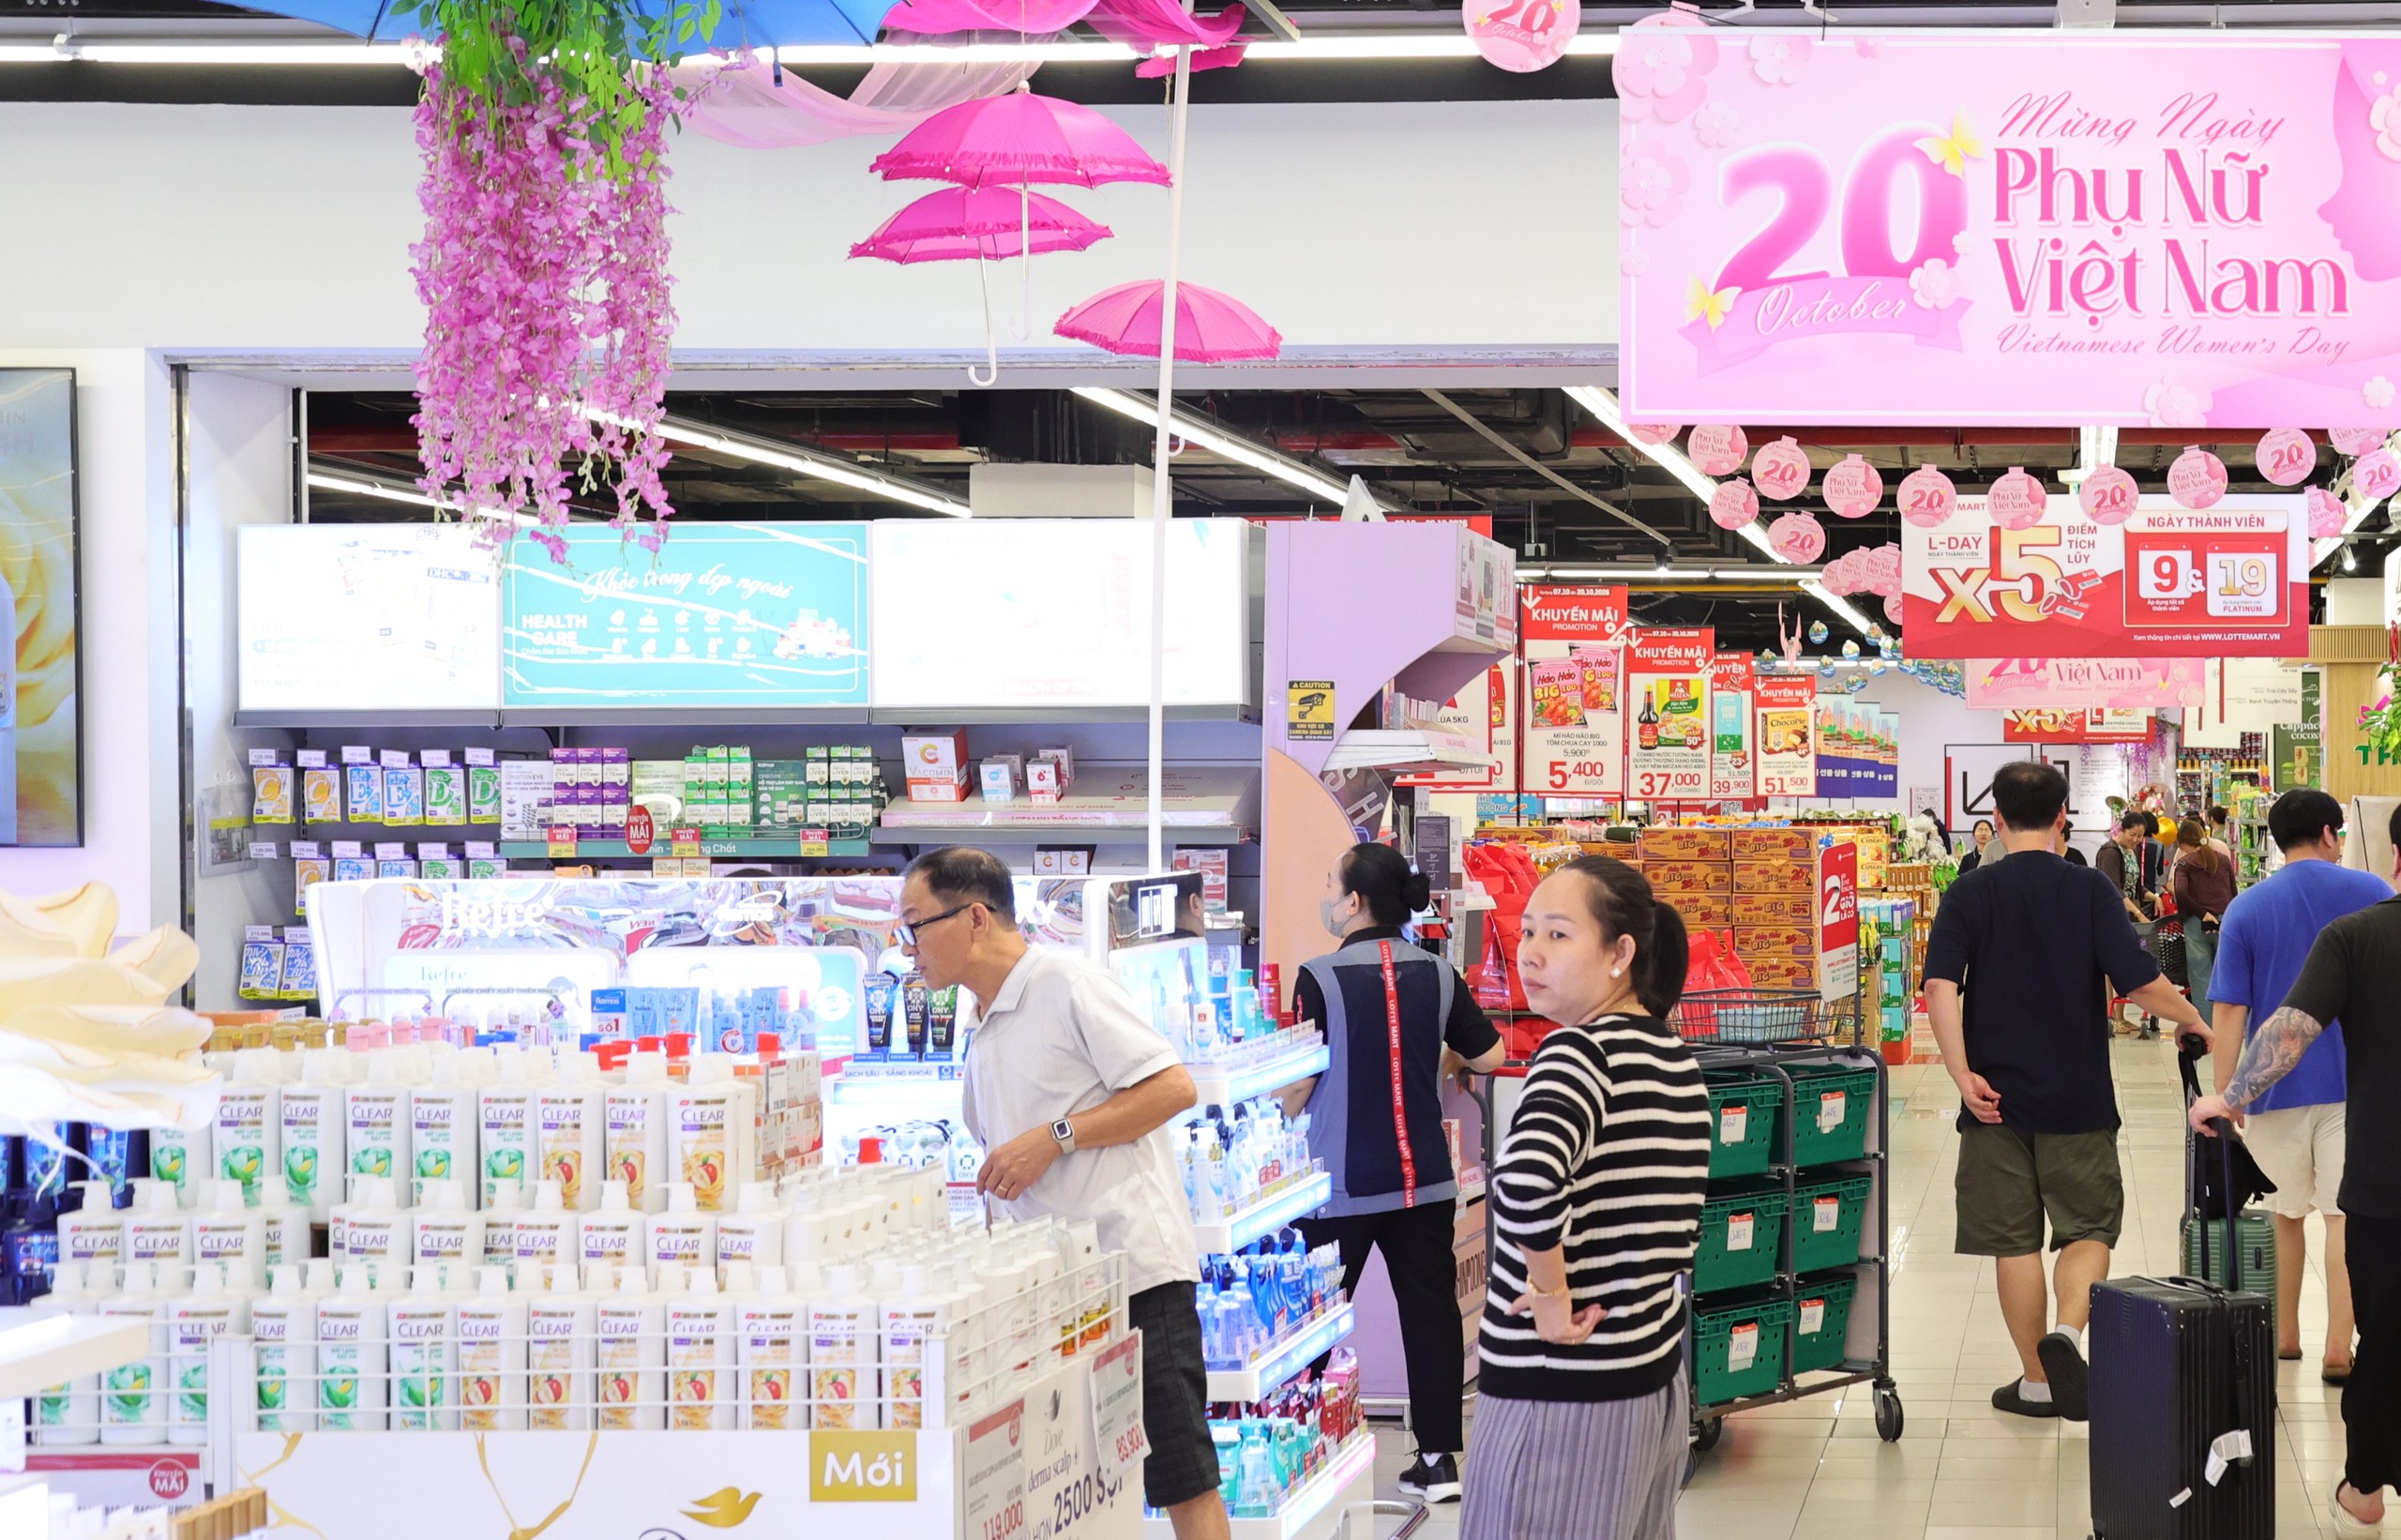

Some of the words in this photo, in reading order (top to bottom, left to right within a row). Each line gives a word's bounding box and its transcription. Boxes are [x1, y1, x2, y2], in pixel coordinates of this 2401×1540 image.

[1998, 91, 2137, 146] Mừng
[2156, 91, 2287, 146] Ngày
[1995, 149, 2144, 237] Phụ
[2162, 149, 2270, 224] Nữ
[1714, 120, 1969, 294] 20
[1995, 237, 2144, 326] Việt
[2163, 239, 2349, 315] Nam
[1755, 282, 1908, 339] October
[1997, 324, 2146, 356] Vietnamese
[2156, 324, 2280, 356] Women's
[2288, 325, 2350, 366] Day
[2271, 444, 2303, 475] 20
[1763, 460, 1799, 481] 20
[2364, 463, 2393, 488] 20
[1910, 489, 1945, 509] 20
[2093, 484, 2127, 511] 20
[1957, 503, 1986, 511] MART
[2148, 514, 2182, 527] NGÀY
[2187, 514, 2231, 527] THÀNH
[2234, 514, 2265, 527] VIÊN
[1786, 530, 1815, 550] 20
[1928, 536, 1983, 550] L-DAY
[2068, 536, 2095, 550] TÍCH
[2068, 552, 2091, 564] LŨY
[2153, 555, 2179, 593] 9
[2185, 568, 2206, 593] &
[2219, 559, 2267, 596] 19
[521, 614, 588, 628] HEALTH
[1532, 606, 1591, 621] KHUYẾN
[1592, 607, 1618, 622] MÃI
[2147, 634, 2163, 642] thông
[1635, 645, 1683, 657] KHUYẾN
[1684, 645, 1706, 657] MÃI
[2056, 660, 2091, 684] Việt
[2096, 663, 2141, 682] Nam
[1534, 684, 1561, 701] BIG
[1760, 687, 1793, 697] KHUYẾN
[1795, 688, 1810, 697] MÃI
[1771, 717, 1805, 728] ChocoPie
[908, 766, 955, 777] VACOMIN
[1548, 762, 1604, 789] 5,400
[430, 781, 449, 802] D
[476, 780, 495, 802] D
[1639, 773, 1700, 795] 37,000
[1713, 780, 1749, 793] 39,900
[1765, 777, 1808, 793] 51,500
[630, 822, 649, 838] MÃI
[713, 842, 736, 853] Chất
[1764, 902, 1784, 912] BIG
[1823, 874, 1841, 927] 2
[1752, 940, 1769, 950] BIG
[1382, 944, 1390, 967] LOTTE
[1385, 970, 1395, 991] MART
[1752, 973, 1769, 983] BIG
[596, 997, 620, 1005] Remos
[1391, 1026, 1399, 1049] MART
[1394, 1084, 1402, 1106] MART
[609, 1107, 645, 1121] CLEAR
[681, 1109, 725, 1123] CLEAR
[1397, 1114, 1405, 1138] LOTTE
[72, 1236, 119, 1250] CLEAR
[133, 1235, 179, 1249] CLEAR
[201, 1235, 244, 1249] CLEAR
[349, 1231, 388, 1246] CLEAR
[421, 1233, 463, 1248] CLEAR
[517, 1234, 557, 1248] CLEAR
[585, 1234, 627, 1248] CLEAR
[657, 1236, 701, 1251] CLEAR
[719, 1236, 753, 1253] CLEAR
[321, 1321, 358, 1336] CLEAR
[399, 1322, 444, 1337] CLEAR
[461, 1321, 500, 1336] CLEAR
[533, 1320, 572, 1336] CLEAR
[1044, 1428, 1064, 1456] Dove
[823, 1451, 903, 1487] Mới
[1028, 1465, 1051, 1493] derma
[1052, 1453, 1071, 1478] scalp
[1054, 1473, 1092, 1534] 2500
